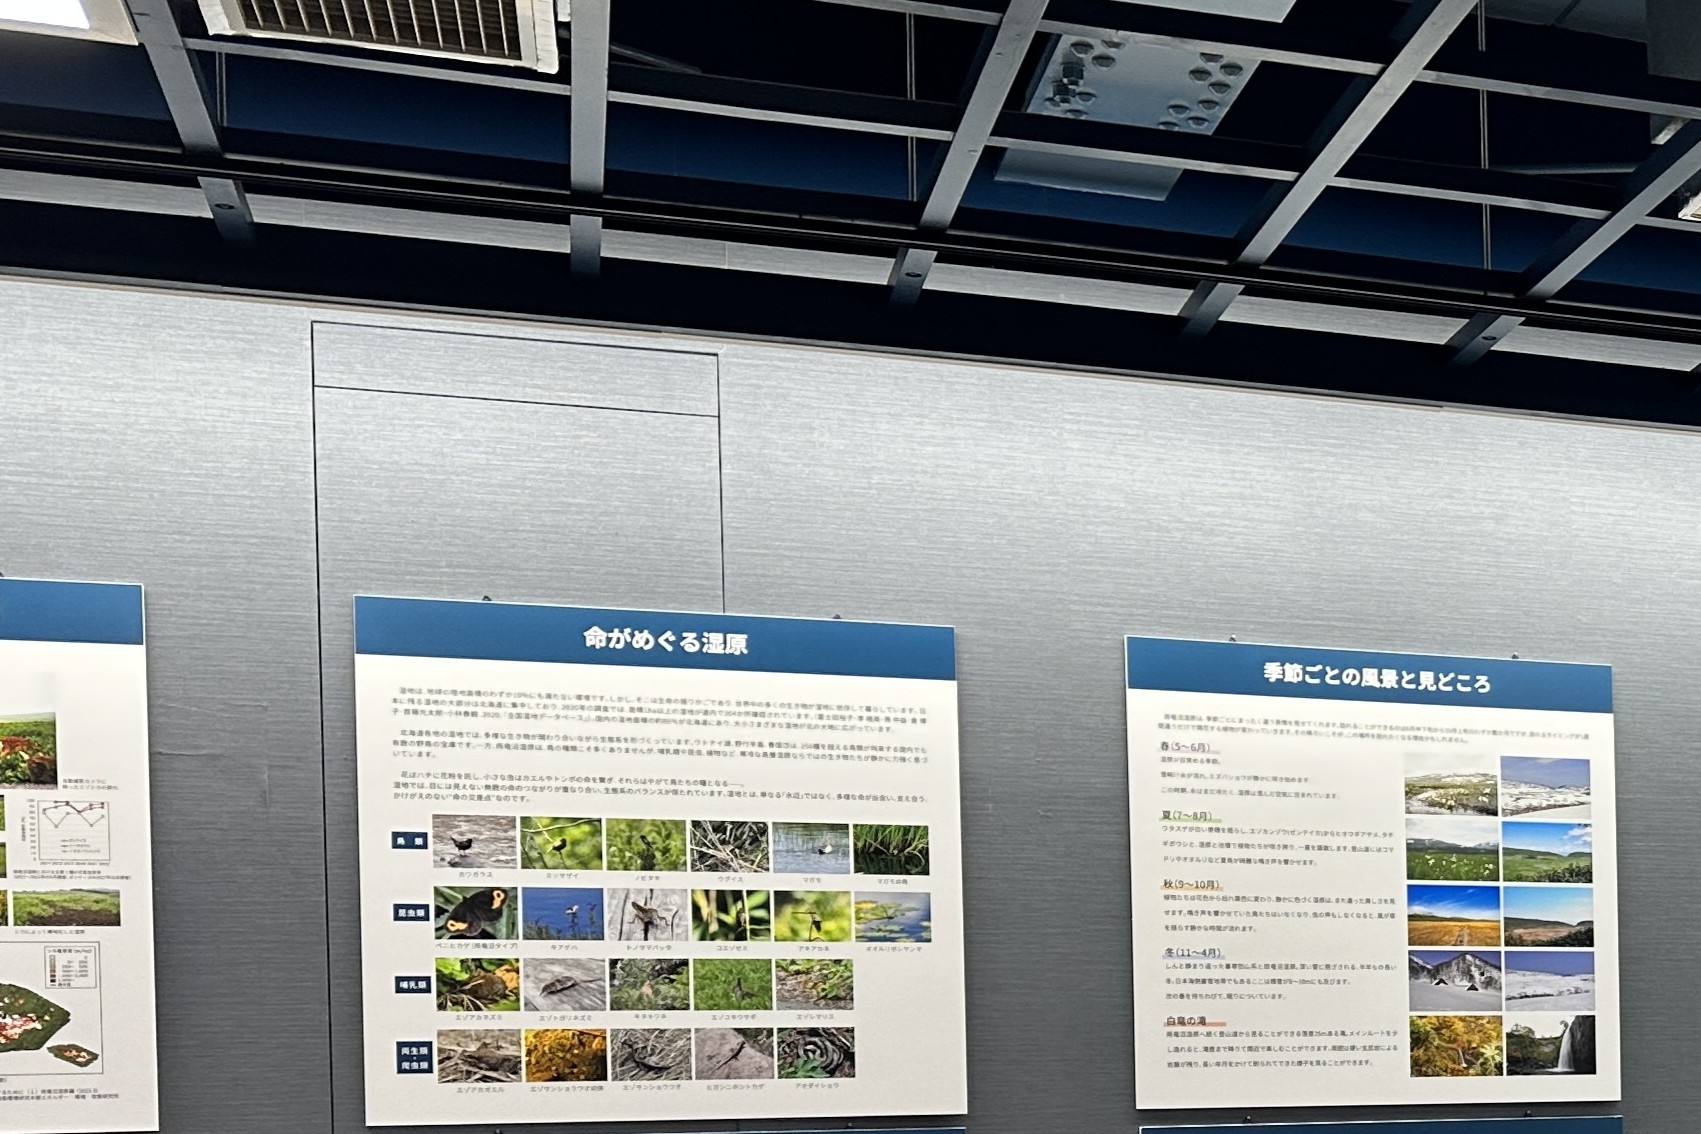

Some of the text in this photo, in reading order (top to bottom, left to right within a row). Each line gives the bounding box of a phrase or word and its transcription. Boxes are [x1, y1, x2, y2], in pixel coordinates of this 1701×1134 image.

[582, 625, 749, 656] 命がめぐる湿原
[1262, 660, 1491, 695] 季節ごとの風景と見どころ
[397, 908, 425, 918] 昆虫類
